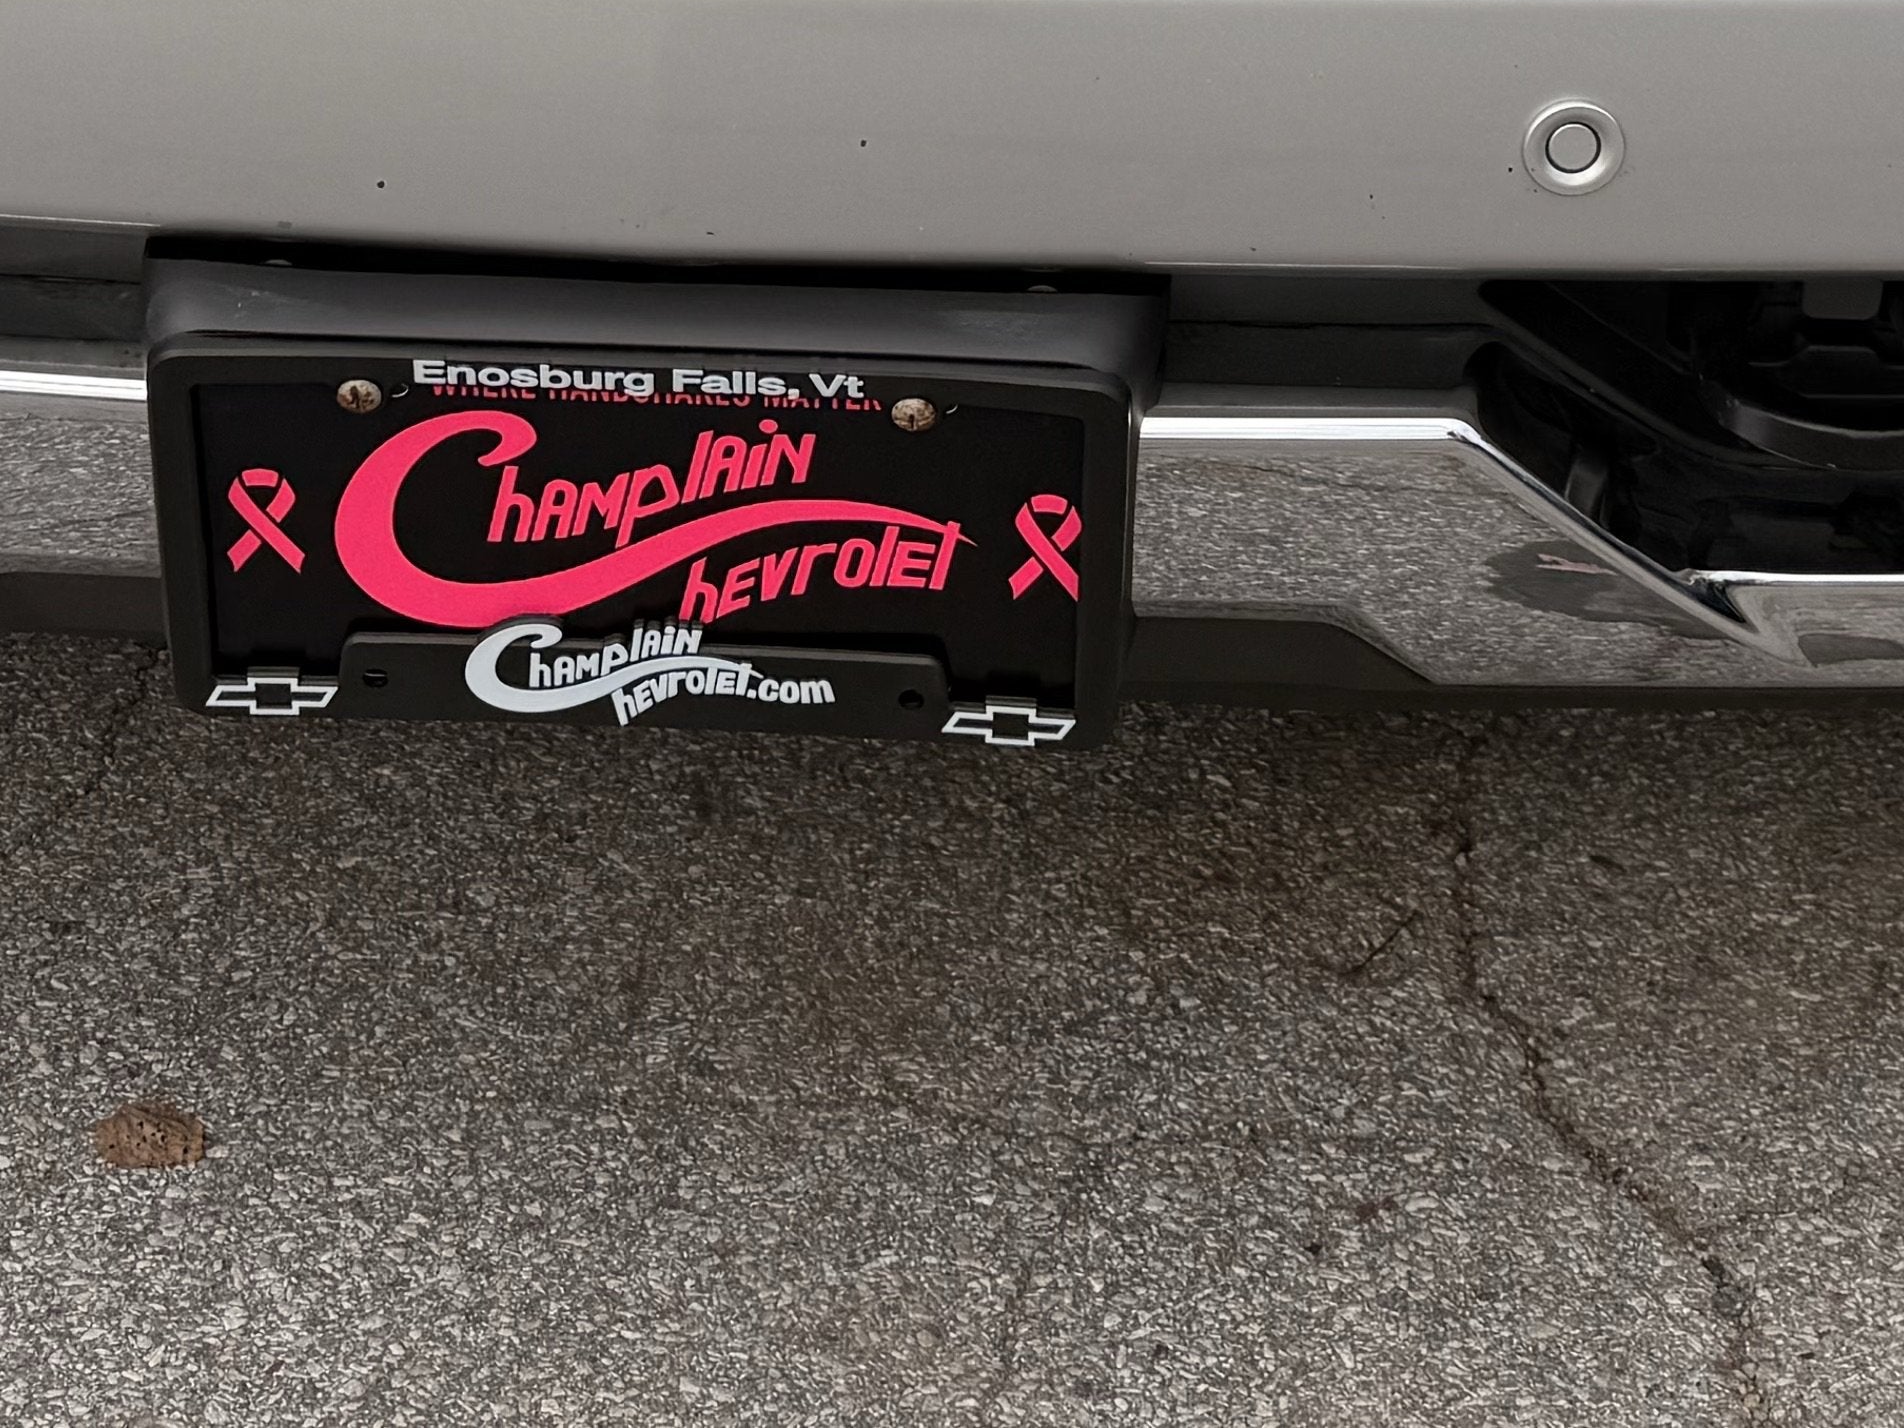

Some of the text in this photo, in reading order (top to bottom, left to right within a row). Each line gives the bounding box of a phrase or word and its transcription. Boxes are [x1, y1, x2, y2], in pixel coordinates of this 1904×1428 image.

[412, 358, 654, 397] Enosburg
[672, 369, 800, 400] Falls,
[808, 372, 865, 399] Vt
